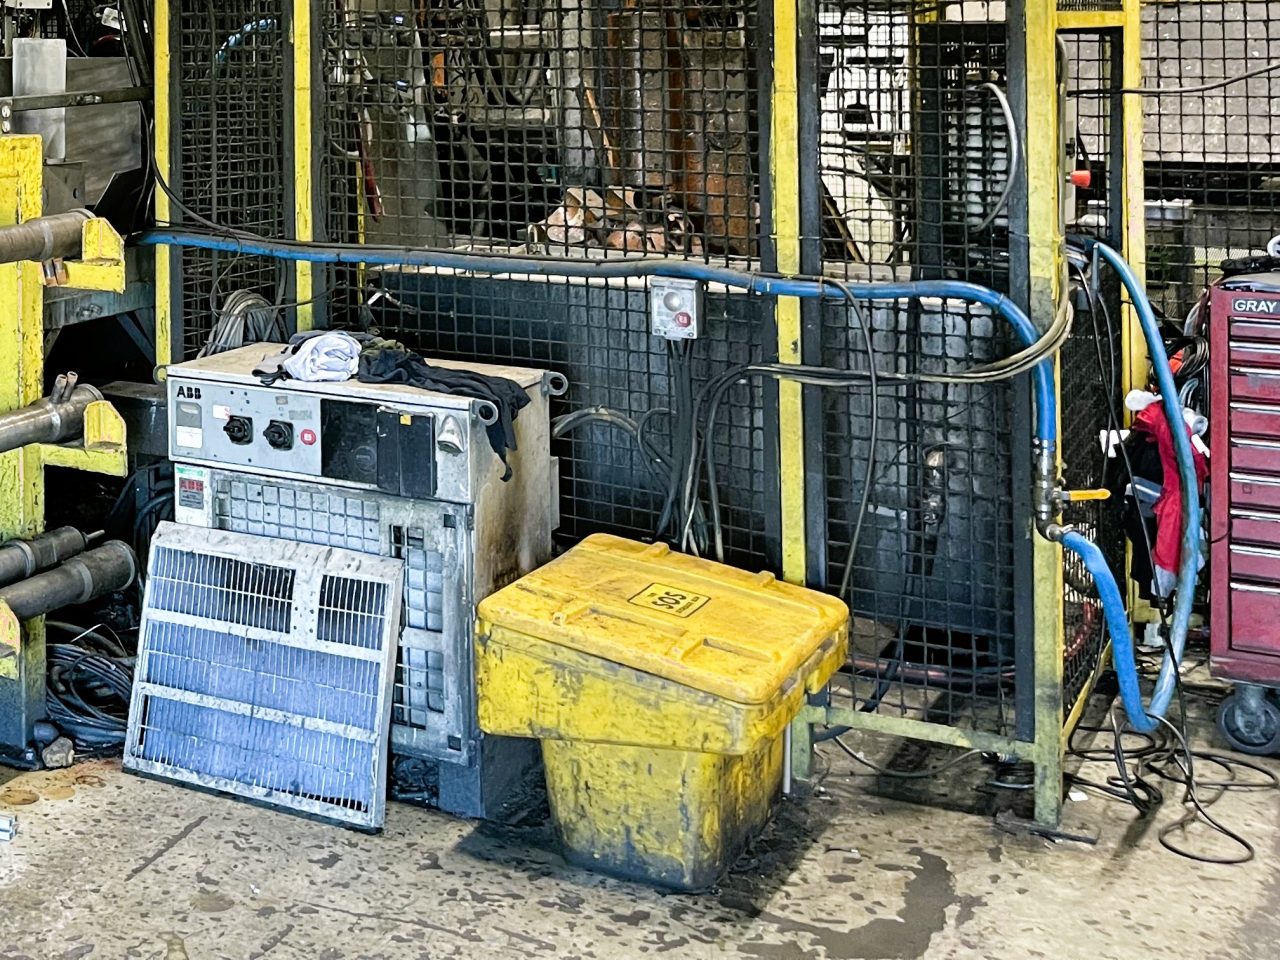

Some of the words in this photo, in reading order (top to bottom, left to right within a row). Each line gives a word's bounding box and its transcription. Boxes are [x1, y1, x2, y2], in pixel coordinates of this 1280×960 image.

[1234, 299, 1278, 313] GRAY
[176, 386, 202, 400] ABB
[180, 478, 204, 492] ABB
[651, 591, 687, 609] SOS
